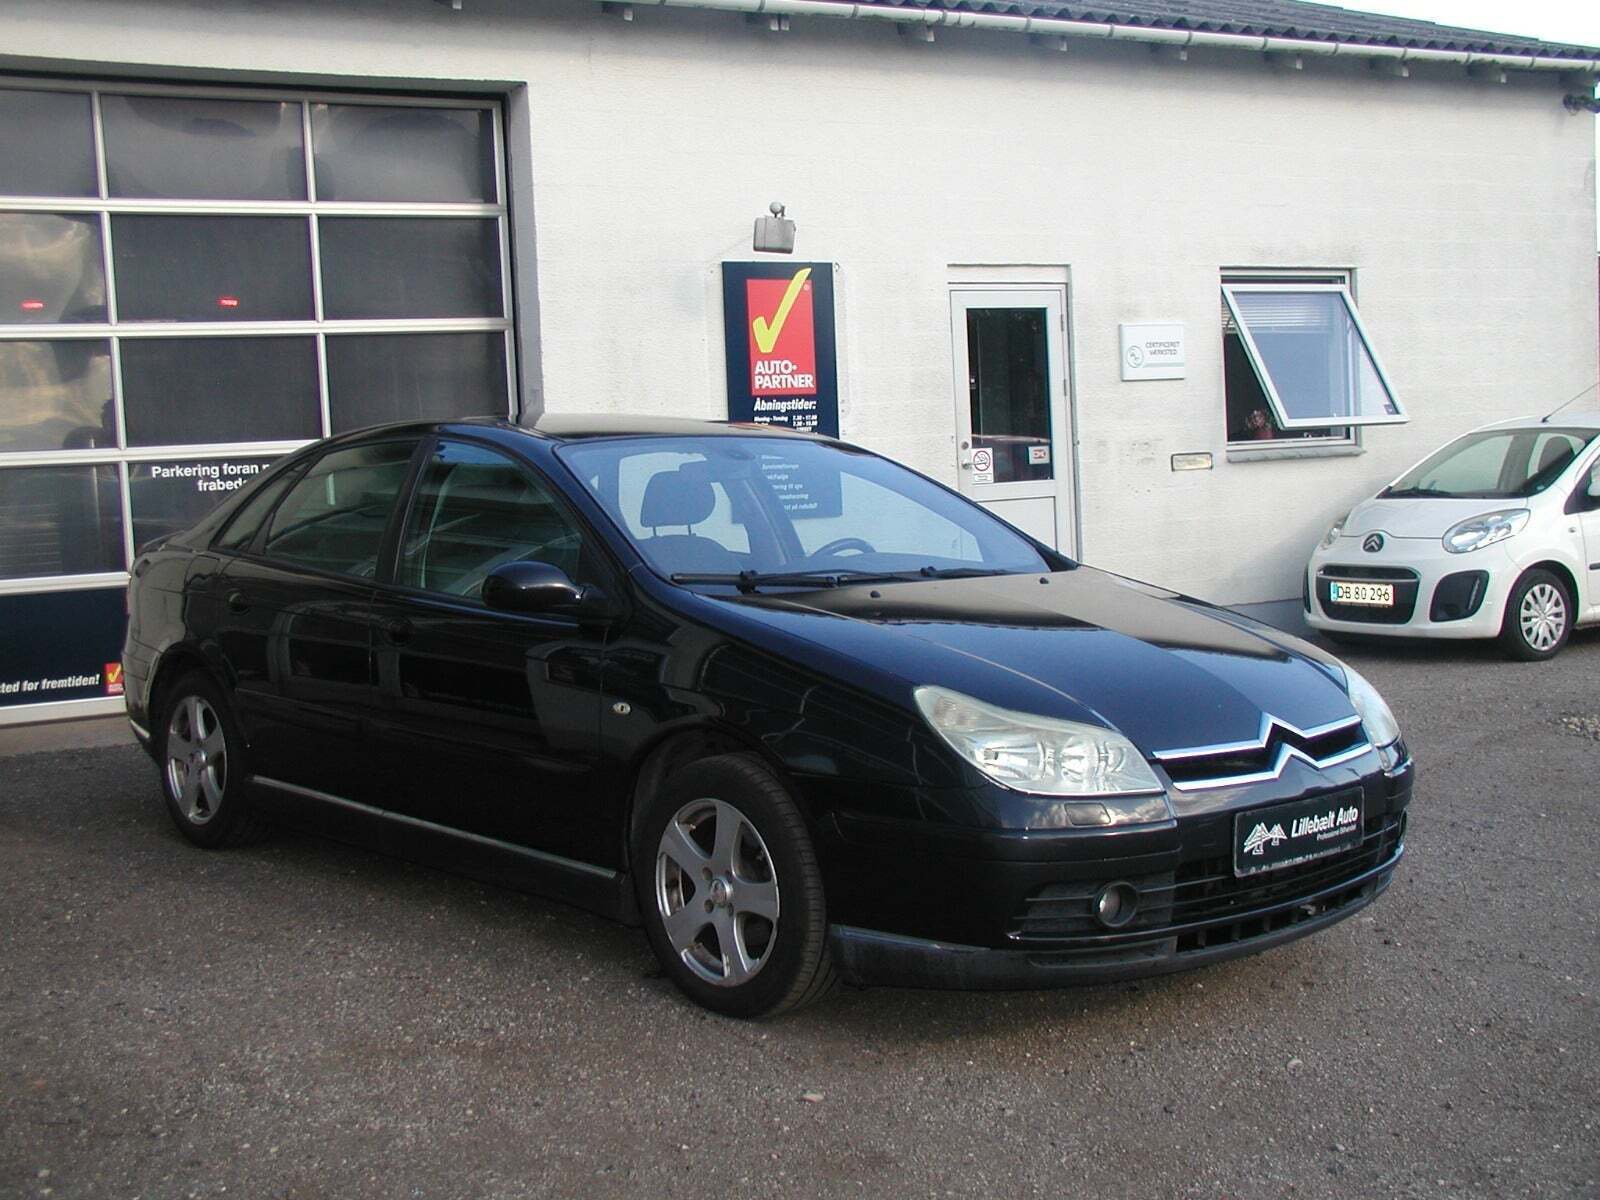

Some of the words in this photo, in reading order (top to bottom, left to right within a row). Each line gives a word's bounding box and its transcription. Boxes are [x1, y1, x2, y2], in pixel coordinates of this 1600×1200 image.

[754, 360, 797, 375] AUTO-
[755, 374, 814, 389] PARTNER
[754, 397, 817, 413] Åbningstider:
[152, 463, 219, 478] Parkering
[223, 463, 258, 476] foran
[1338, 586, 1351, 599] DB
[1354, 586, 1367, 600] 80
[1370, 588, 1390, 601] 296
[22, 680, 39, 692] for
[41, 673, 100, 690] fremtiden!
[1291, 810, 1335, 838] Lillebælt
[1336, 806, 1358, 826] Auto
